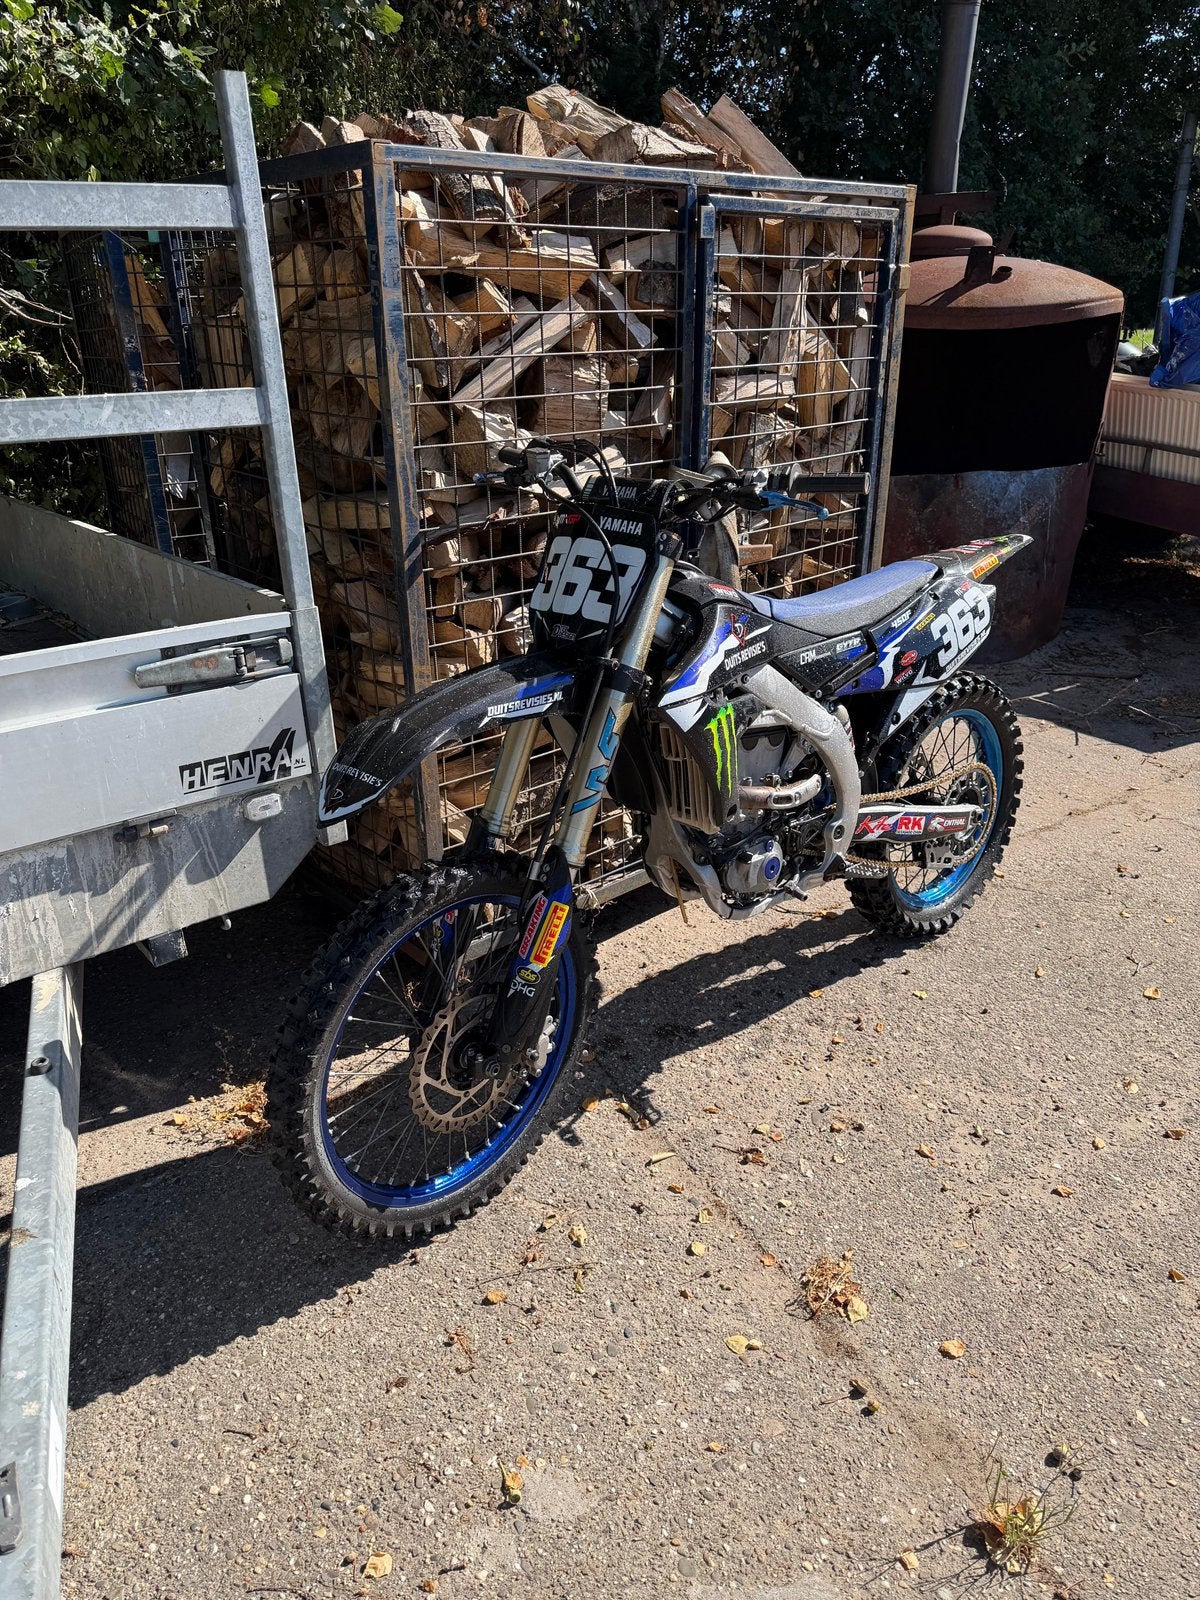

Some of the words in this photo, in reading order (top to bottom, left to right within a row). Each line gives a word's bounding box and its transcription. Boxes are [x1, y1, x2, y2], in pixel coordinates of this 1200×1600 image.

[599, 516, 643, 536] YAMAHA
[530, 536, 647, 624] 363
[930, 588, 990, 667] 363
[487, 691, 564, 717] DUITSREVISIES.NL
[897, 816, 925, 831] RK
[519, 896, 547, 958] BRAKING
[532, 904, 567, 965] PIRELLI
[511, 979, 536, 997] DHG
